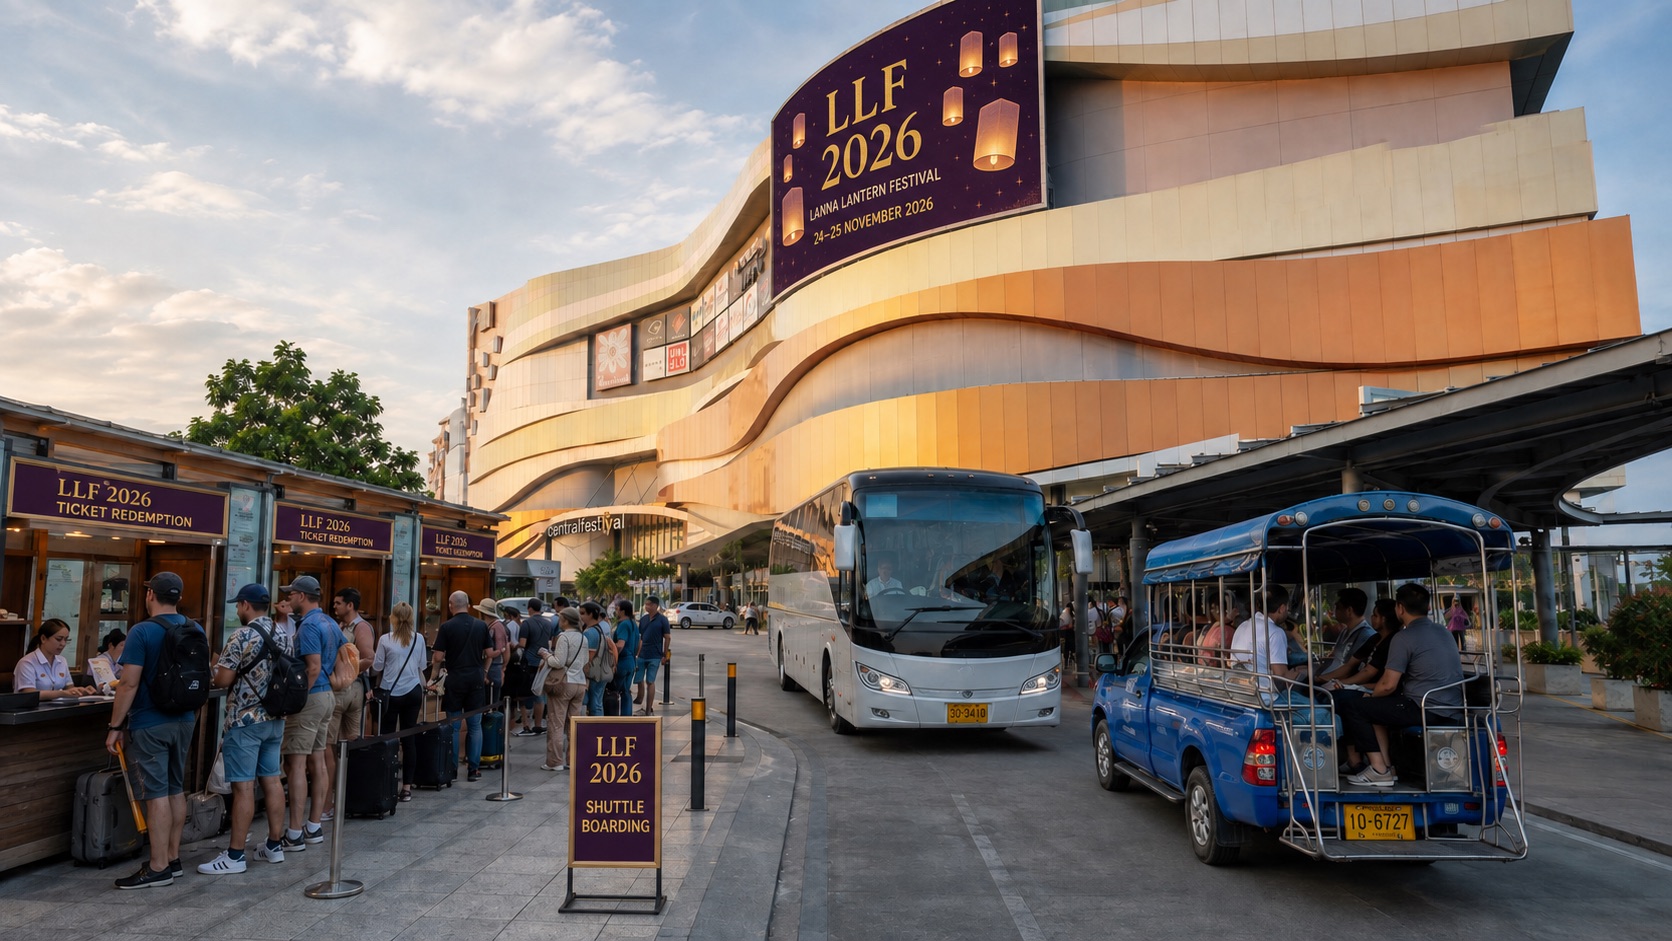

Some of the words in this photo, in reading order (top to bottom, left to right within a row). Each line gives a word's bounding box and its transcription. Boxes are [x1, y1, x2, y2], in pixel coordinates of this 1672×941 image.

[826, 59, 907, 137] LLF
[821, 111, 922, 190] 2026
[810, 199, 839, 222] LANNA
[841, 182, 886, 209] LANTERN
[889, 168, 941, 193] FESTIVAL
[844, 205, 902, 234] NOVEMBER
[905, 196, 934, 216] 2026
[57, 478, 100, 500] LLF
[106, 486, 152, 507] 2026
[56, 501, 108, 518] TICKET
[111, 507, 192, 528] REDEMPTION
[300, 514, 323, 529] LLF
[326, 518, 351, 533] 2026
[300, 530, 328, 542] TICKET
[329, 534, 374, 547] REDEMPTION
[435, 533, 450, 545] LLF
[596, 736, 637, 757] LLF
[589, 762, 642, 784] 2026
[586, 800, 644, 814] SHUTTLE
[581, 819, 650, 833] BOARDING
[1350, 813, 1409, 830] 10-6727
